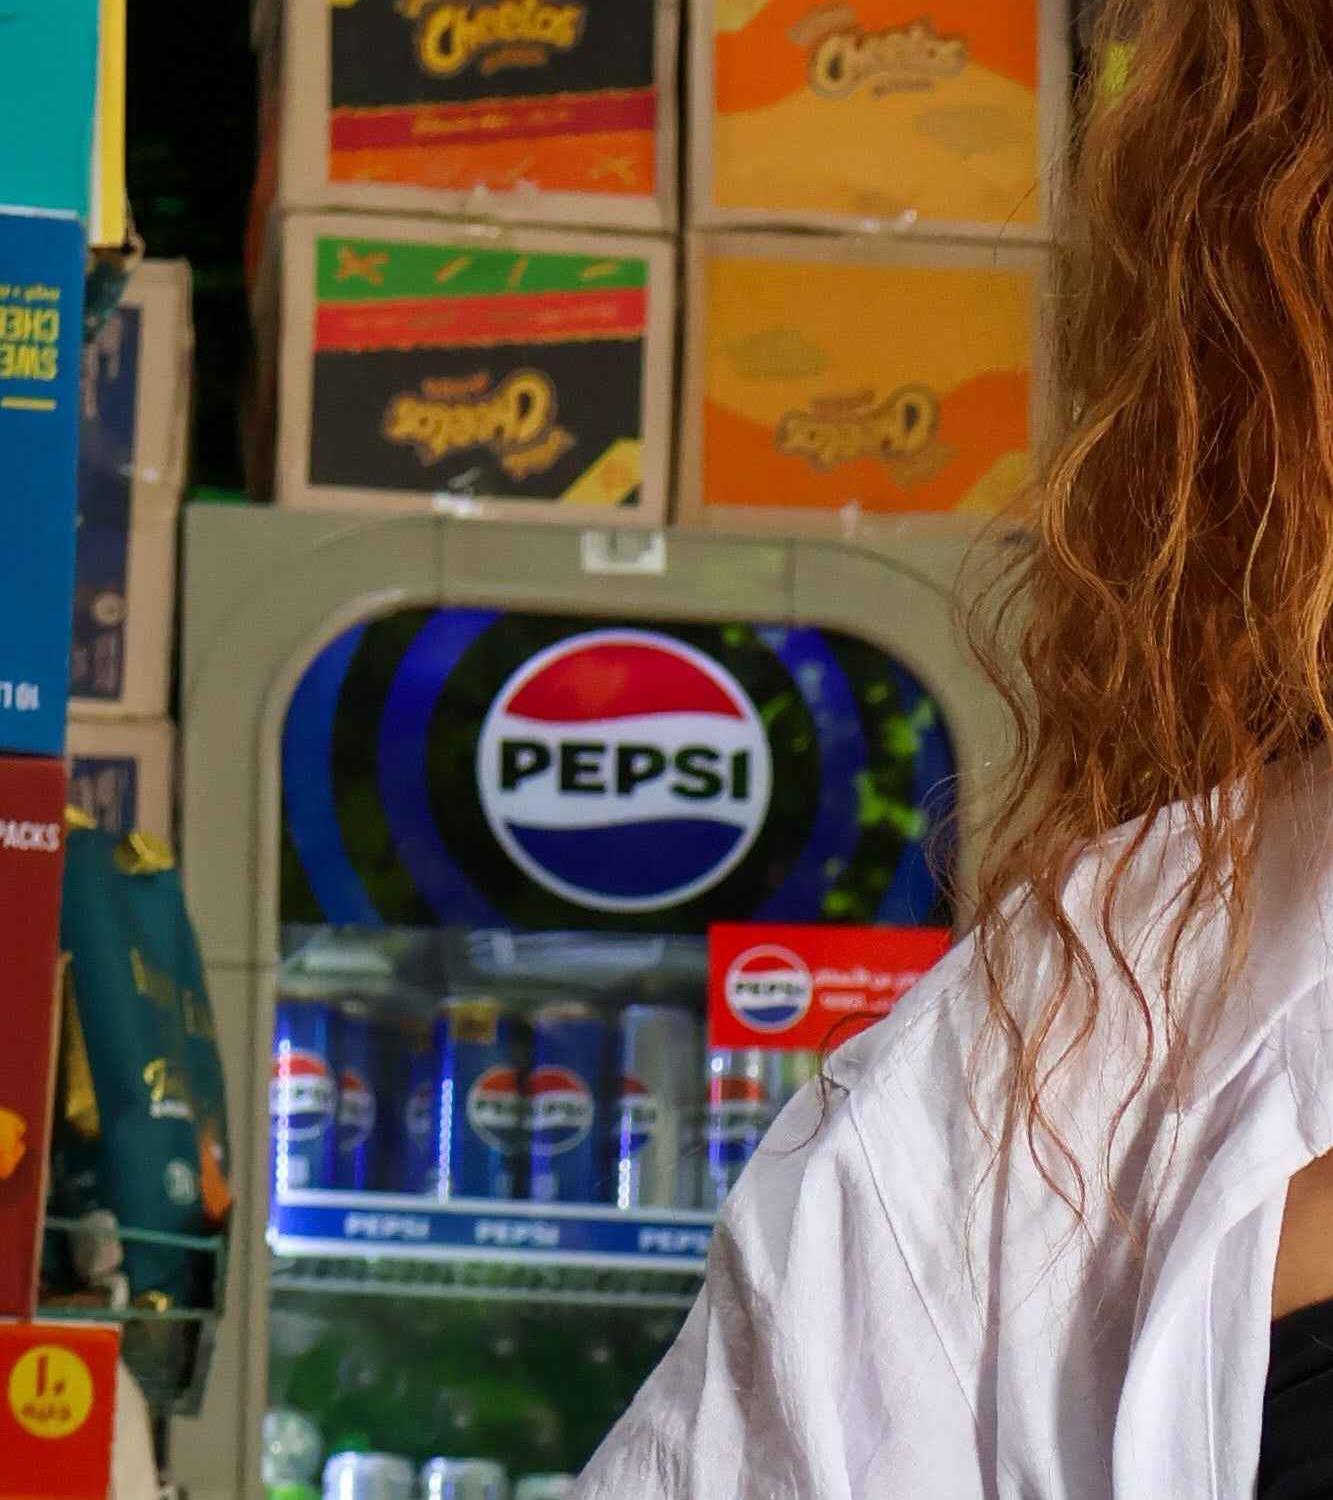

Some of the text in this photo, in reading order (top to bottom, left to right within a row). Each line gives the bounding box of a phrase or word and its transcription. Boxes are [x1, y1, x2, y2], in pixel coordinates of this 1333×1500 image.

[499, 740, 752, 803] PEPSI
[345, 1212, 431, 1239] PEPSI
[473, 1219, 560, 1246] PEPSI
